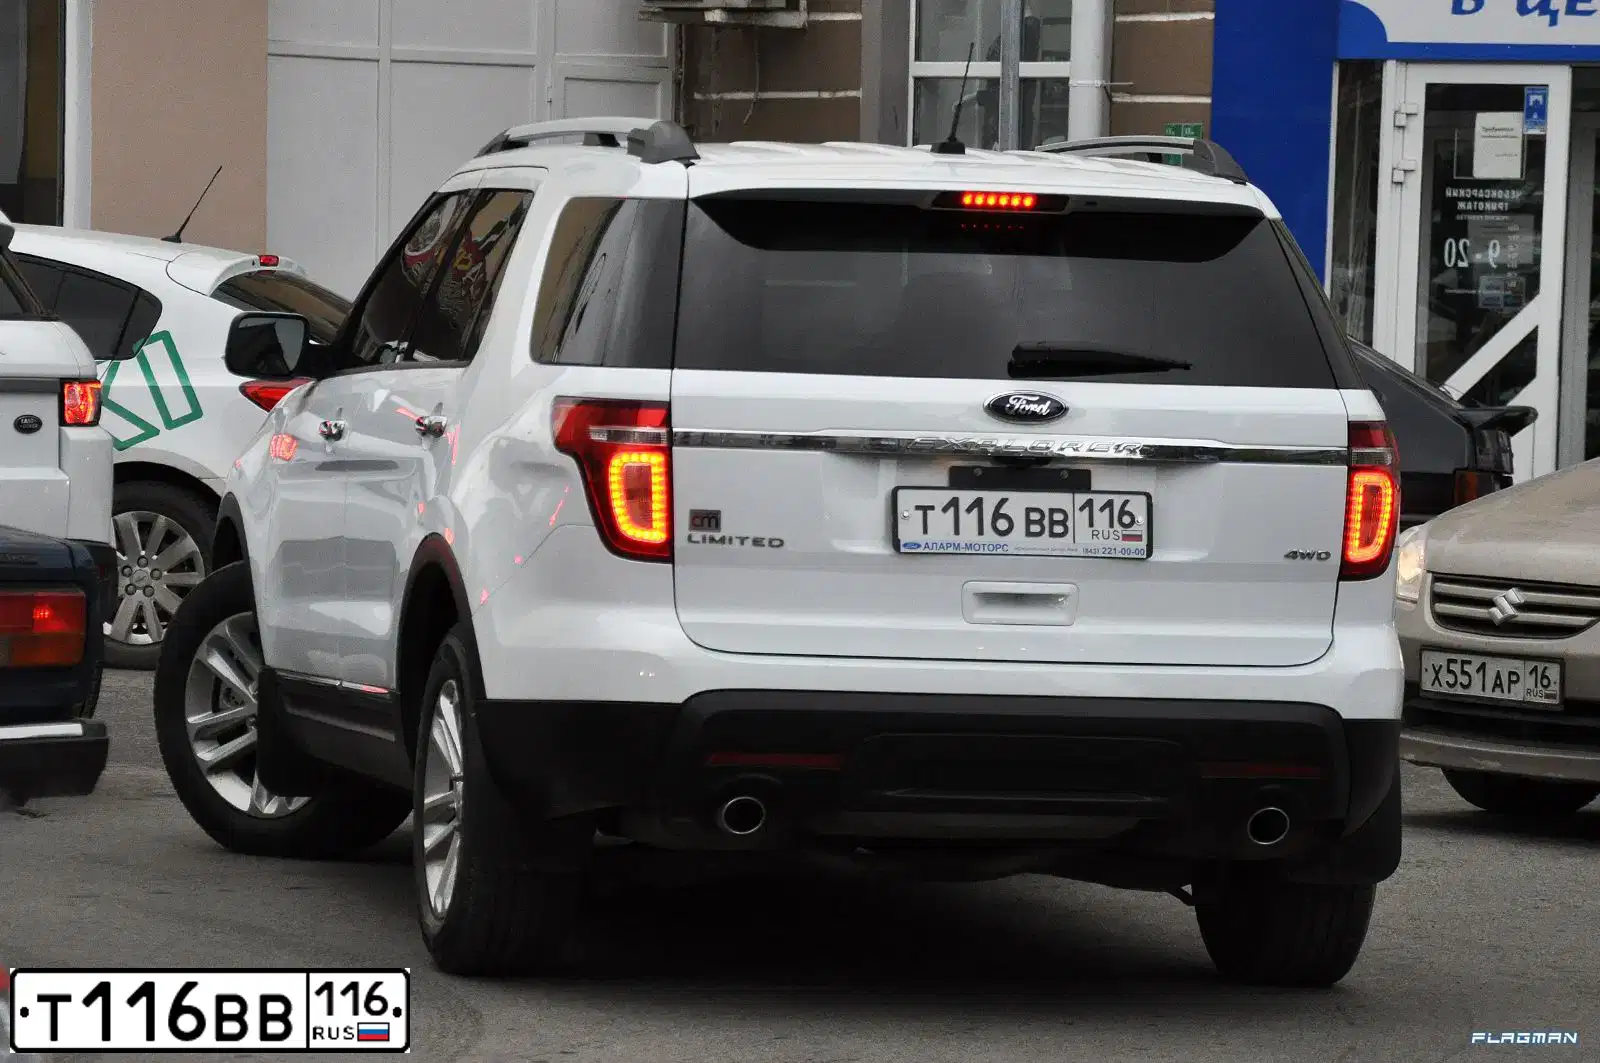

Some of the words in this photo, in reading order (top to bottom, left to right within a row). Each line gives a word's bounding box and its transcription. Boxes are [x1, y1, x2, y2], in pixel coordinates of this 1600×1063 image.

[1005, 395, 1051, 417] Ford
[906, 436, 1146, 455] EXPLORER
[914, 496, 1069, 538] Т116ВВ
[1078, 498, 1136, 529] 116
[687, 533, 785, 548] LIMITED
[1091, 530, 1121, 541] RUS
[923, 542, 1009, 553] АЛАРМ-МОТОРС
[1101, 546, 1146, 556] 221-00-00
[1283, 550, 1331, 561] 4WD
[1430, 658, 1521, 694] Х551АР
[1528, 665, 1551, 689] 16
[1526, 688, 1544, 698] RUS
